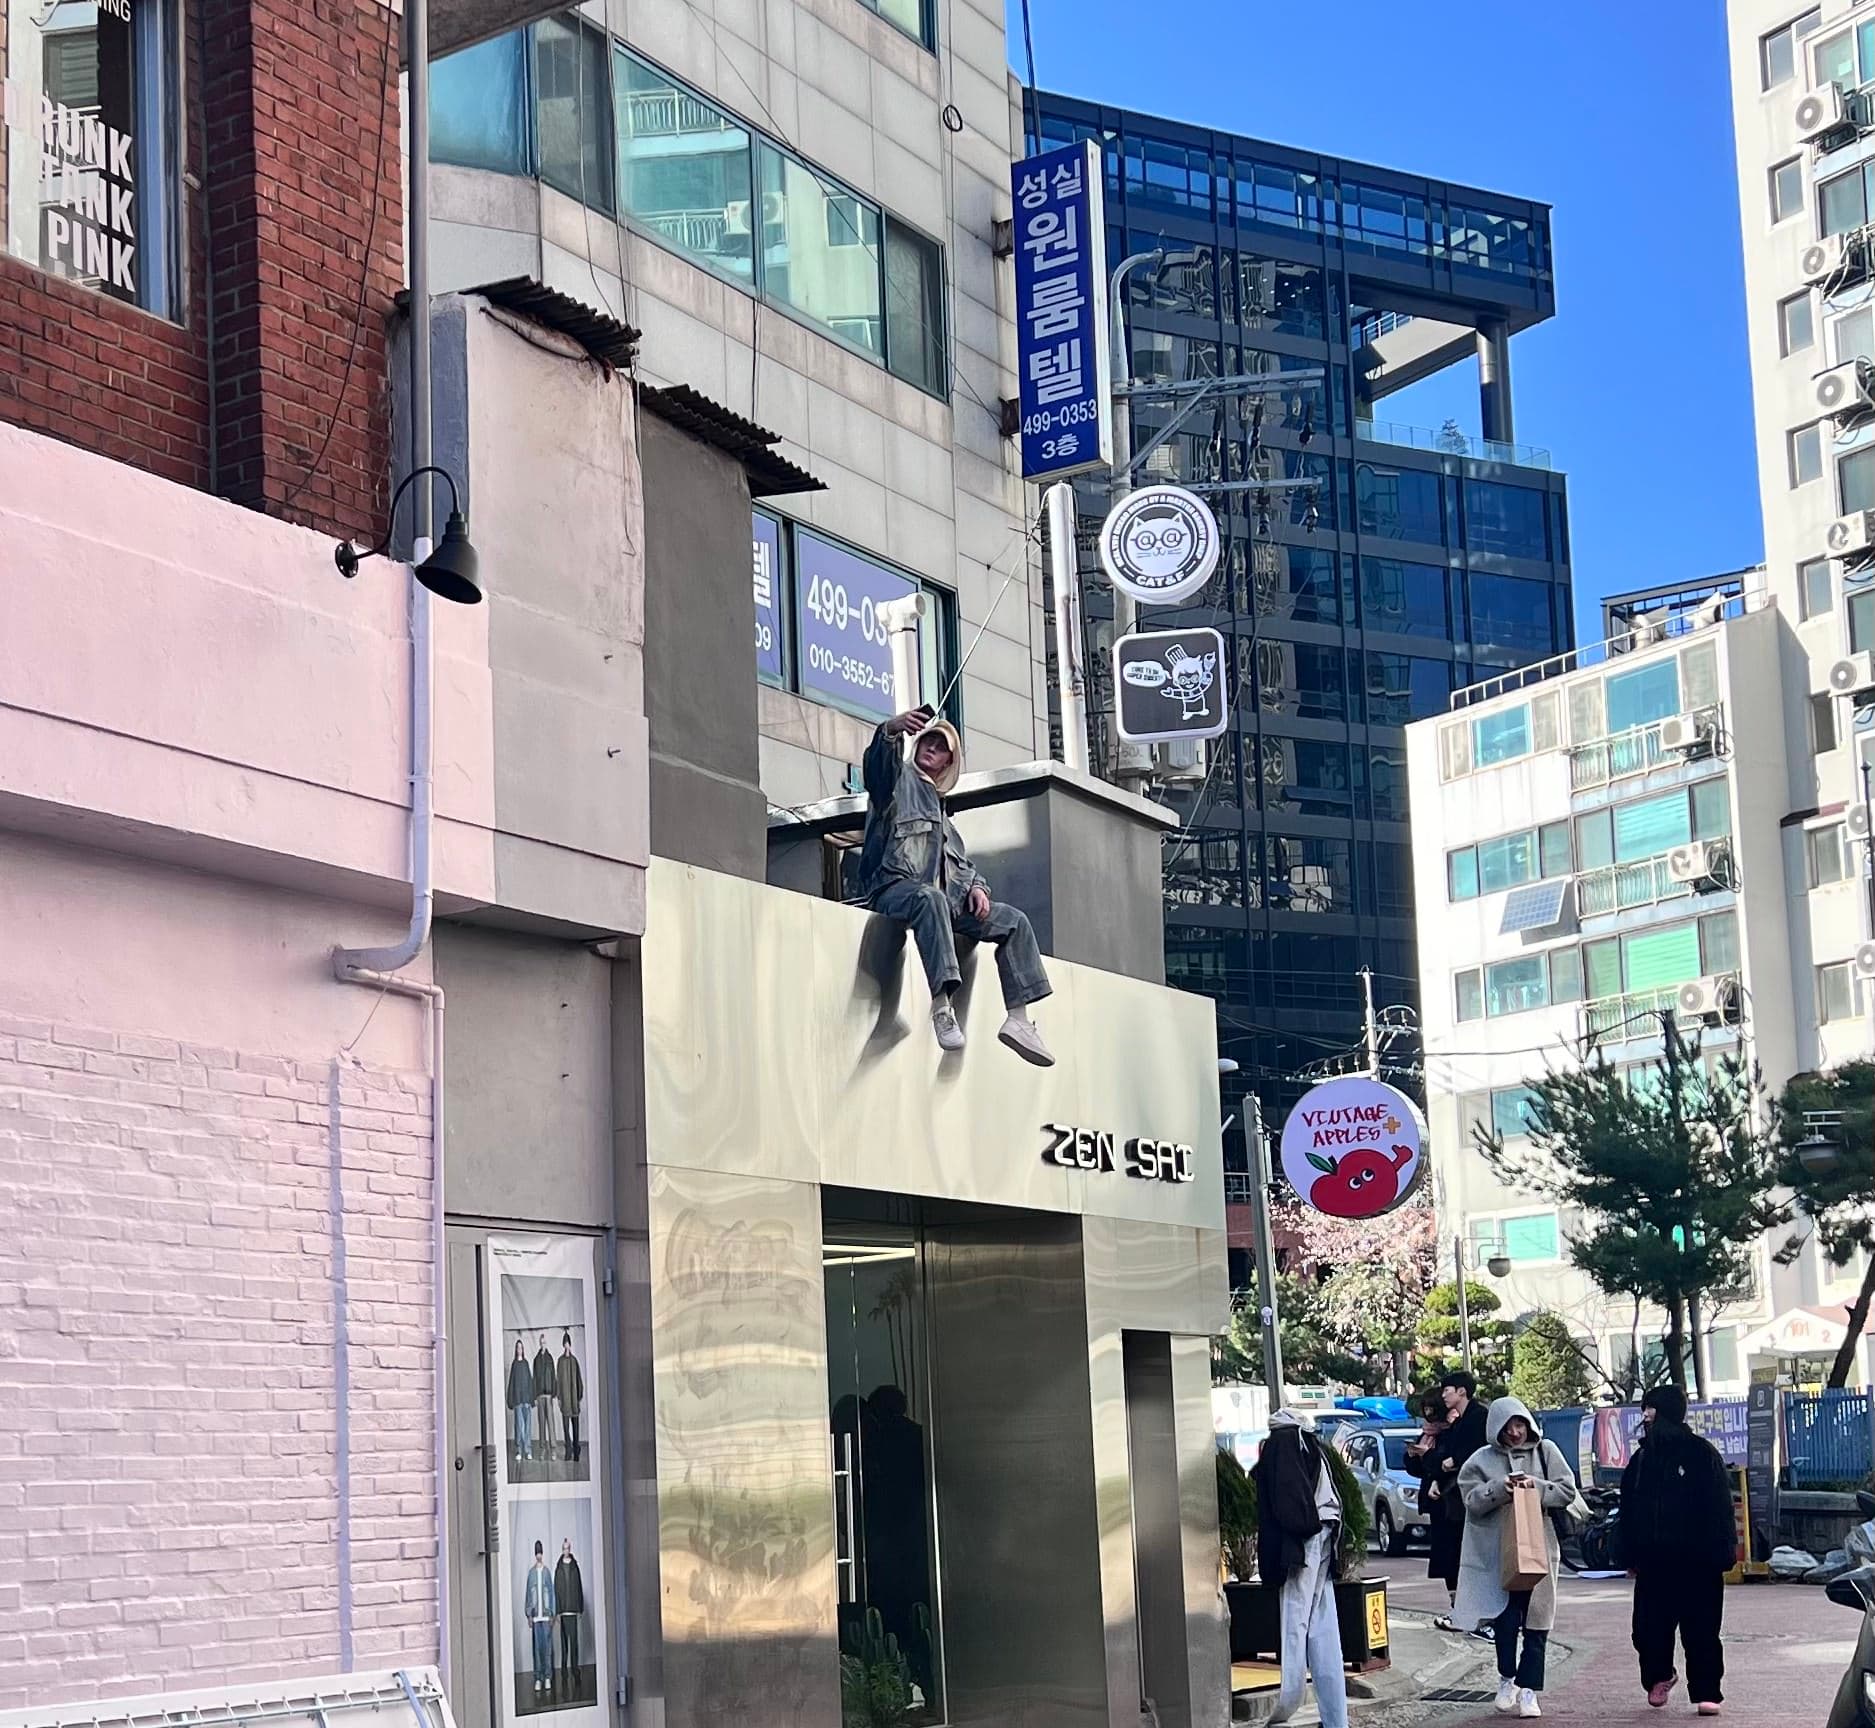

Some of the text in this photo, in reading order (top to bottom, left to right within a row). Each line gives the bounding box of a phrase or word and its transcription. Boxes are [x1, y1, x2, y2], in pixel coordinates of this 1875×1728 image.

[39, 152, 134, 238] TANK
[1018, 158, 1082, 209] 성실
[48, 209, 135, 292] PINK
[1024, 205, 1085, 405] 원룸텔
[1023, 399, 1097, 436] 499-0353
[1041, 433, 1079, 460] 3층
[1136, 570, 1185, 586] CAT&F
[807, 574, 891, 646] 499-03
[1302, 1104, 1388, 1127] VINTAGE
[1313, 1126, 1381, 1148] APPLES
[1049, 1123, 1195, 1182] ZEN SAI
